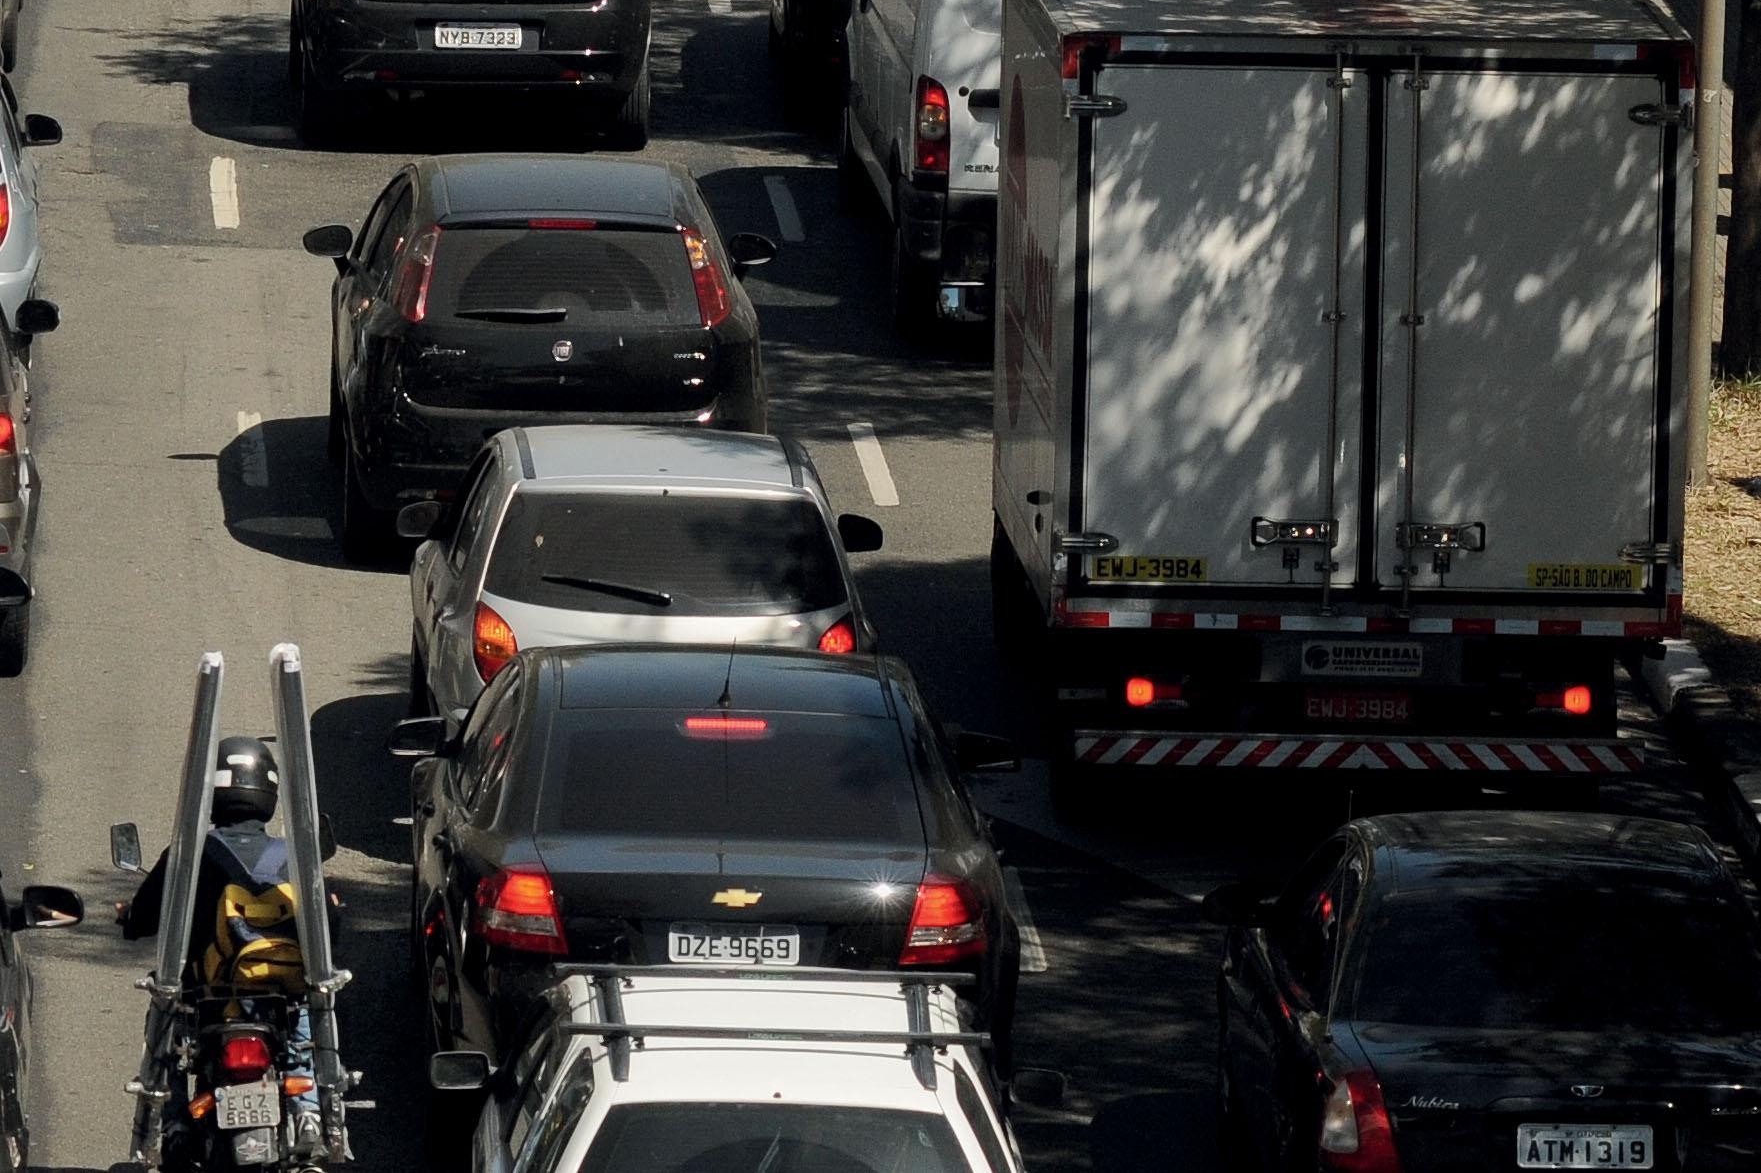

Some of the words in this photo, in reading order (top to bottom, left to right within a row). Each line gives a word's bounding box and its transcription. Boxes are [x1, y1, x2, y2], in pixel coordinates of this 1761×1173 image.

[1096, 558, 1202, 578] EWJ-3984
[1332, 647, 1420, 659] UNIVERSAL
[1307, 699, 1408, 719] EWJ-3984
[677, 936, 790, 959] DZE-9669
[1527, 1140, 1646, 1164] ATM-1319
